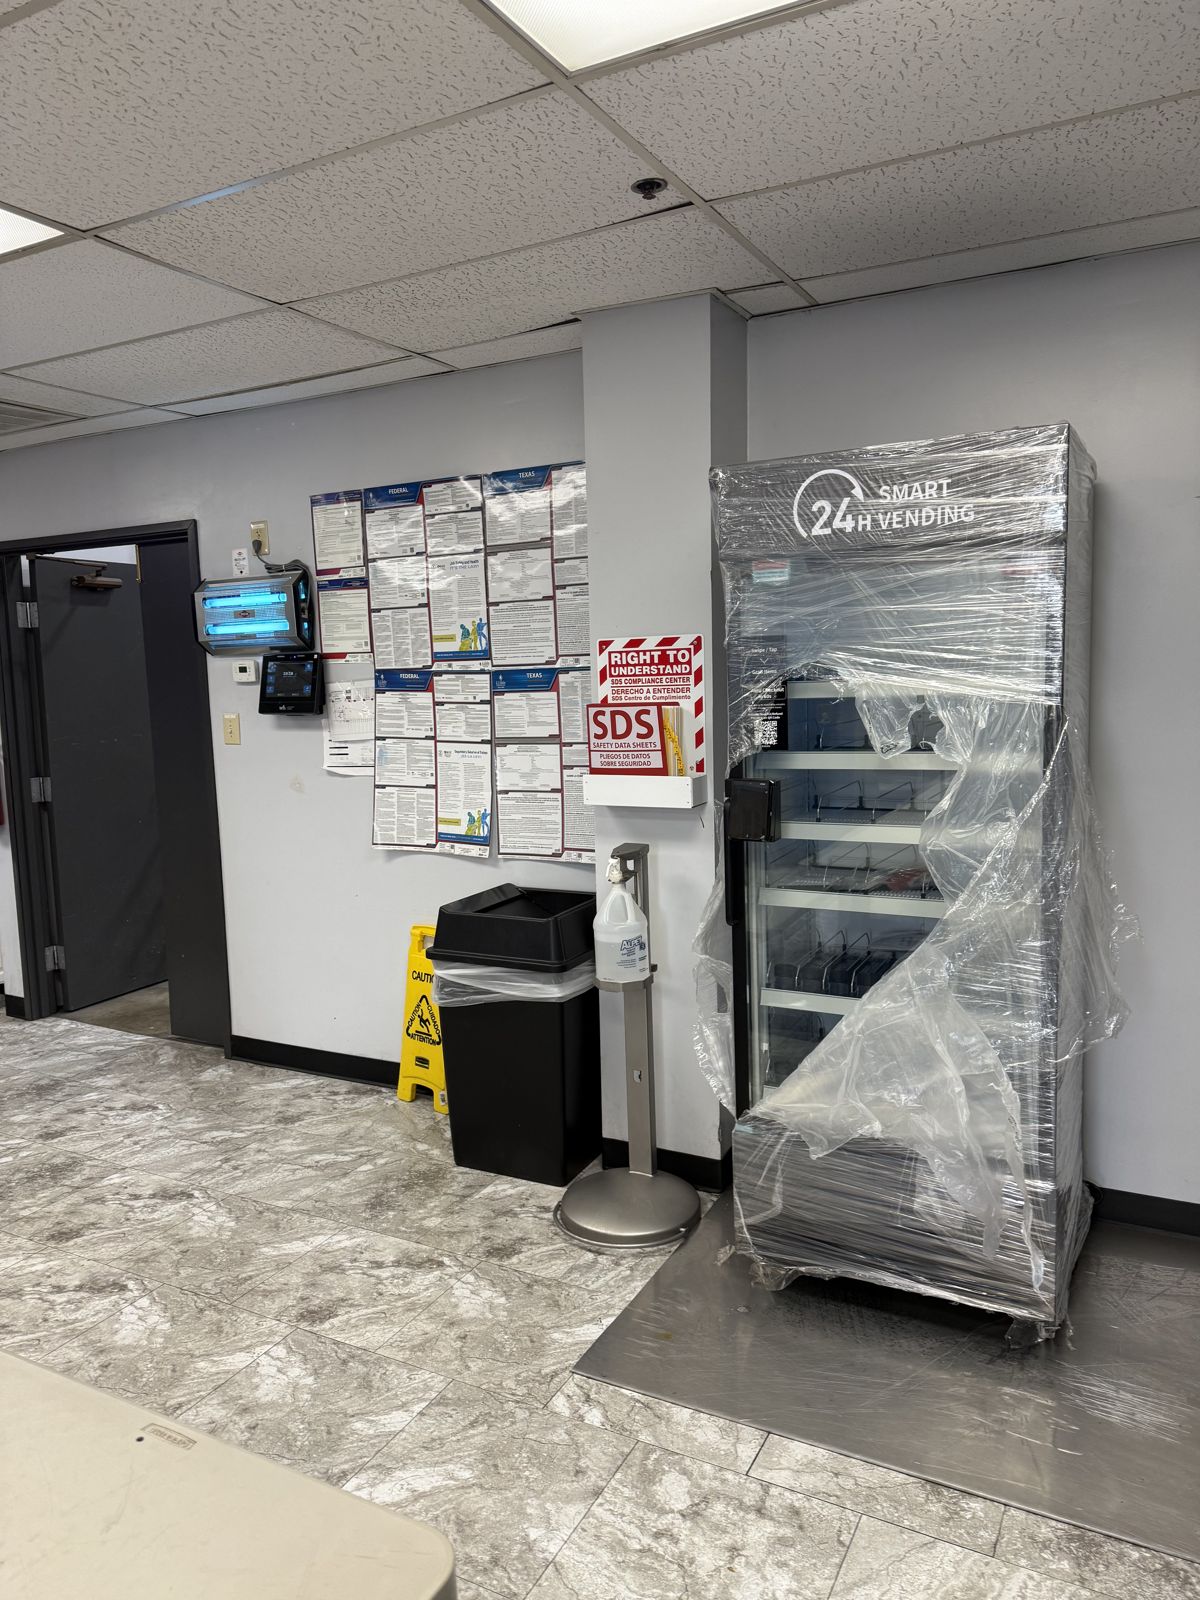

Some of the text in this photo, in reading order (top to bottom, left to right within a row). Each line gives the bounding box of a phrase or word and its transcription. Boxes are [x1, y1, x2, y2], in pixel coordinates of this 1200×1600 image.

[388, 487, 408, 495] FEDERAL
[879, 479, 952, 502] SMART
[879, 504, 975, 530] VENDING
[611, 650, 690, 665] RIGHT TO
[611, 664, 690, 676] UNDERSTAND
[611, 676, 691, 686] SDS COMPLIANCE CENTER
[652, 694, 691, 702] Cumplimiento
[593, 709, 654, 740] SDS
[632, 741, 657, 749] SHEETS
[412, 970, 434, 983] CAUTI
[408, 1002, 422, 1027] CAUTION
[427, 1004, 440, 1035] CUIDADO
[410, 1033, 438, 1046] ATTENTION
